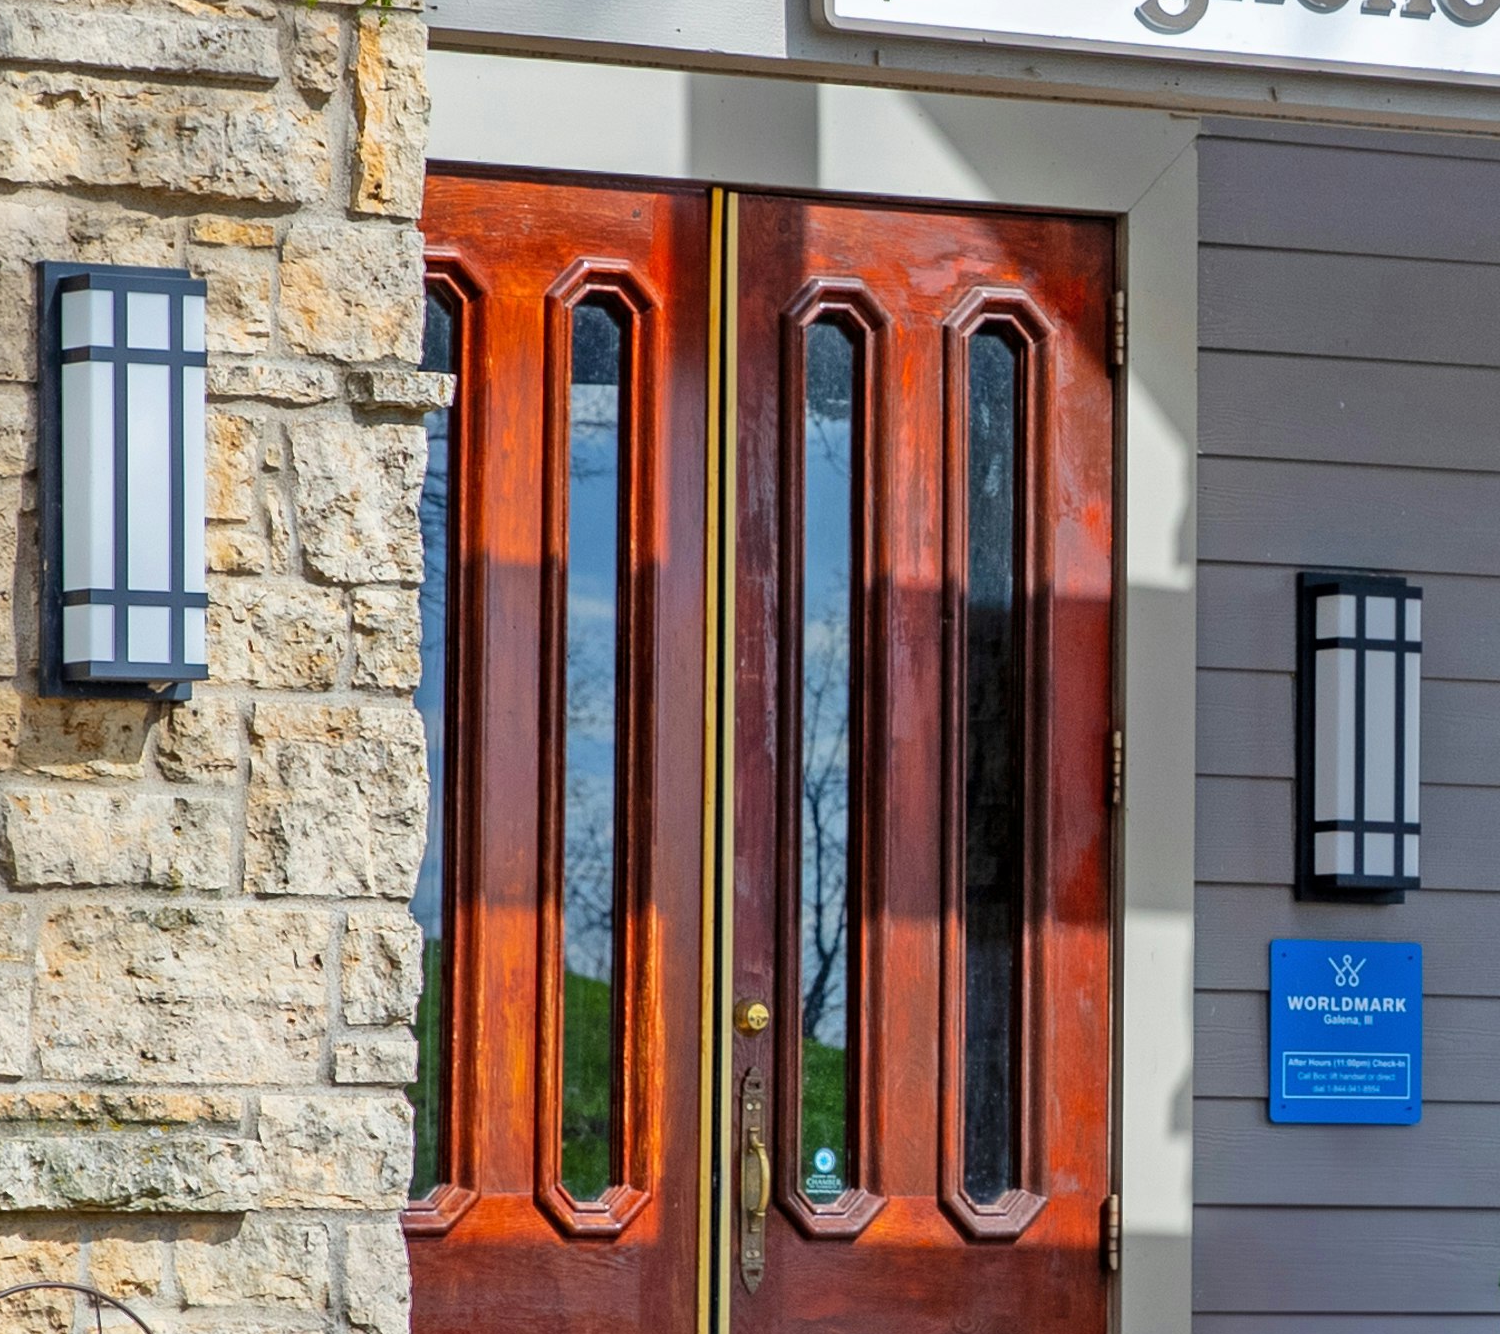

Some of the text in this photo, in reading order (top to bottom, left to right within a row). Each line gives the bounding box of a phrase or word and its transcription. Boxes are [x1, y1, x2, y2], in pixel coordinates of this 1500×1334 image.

[1287, 995, 1406, 1012] WORLDMARK
[1323, 1013, 1361, 1026] Galena,
[1308, 1058, 1332, 1067] Hours
